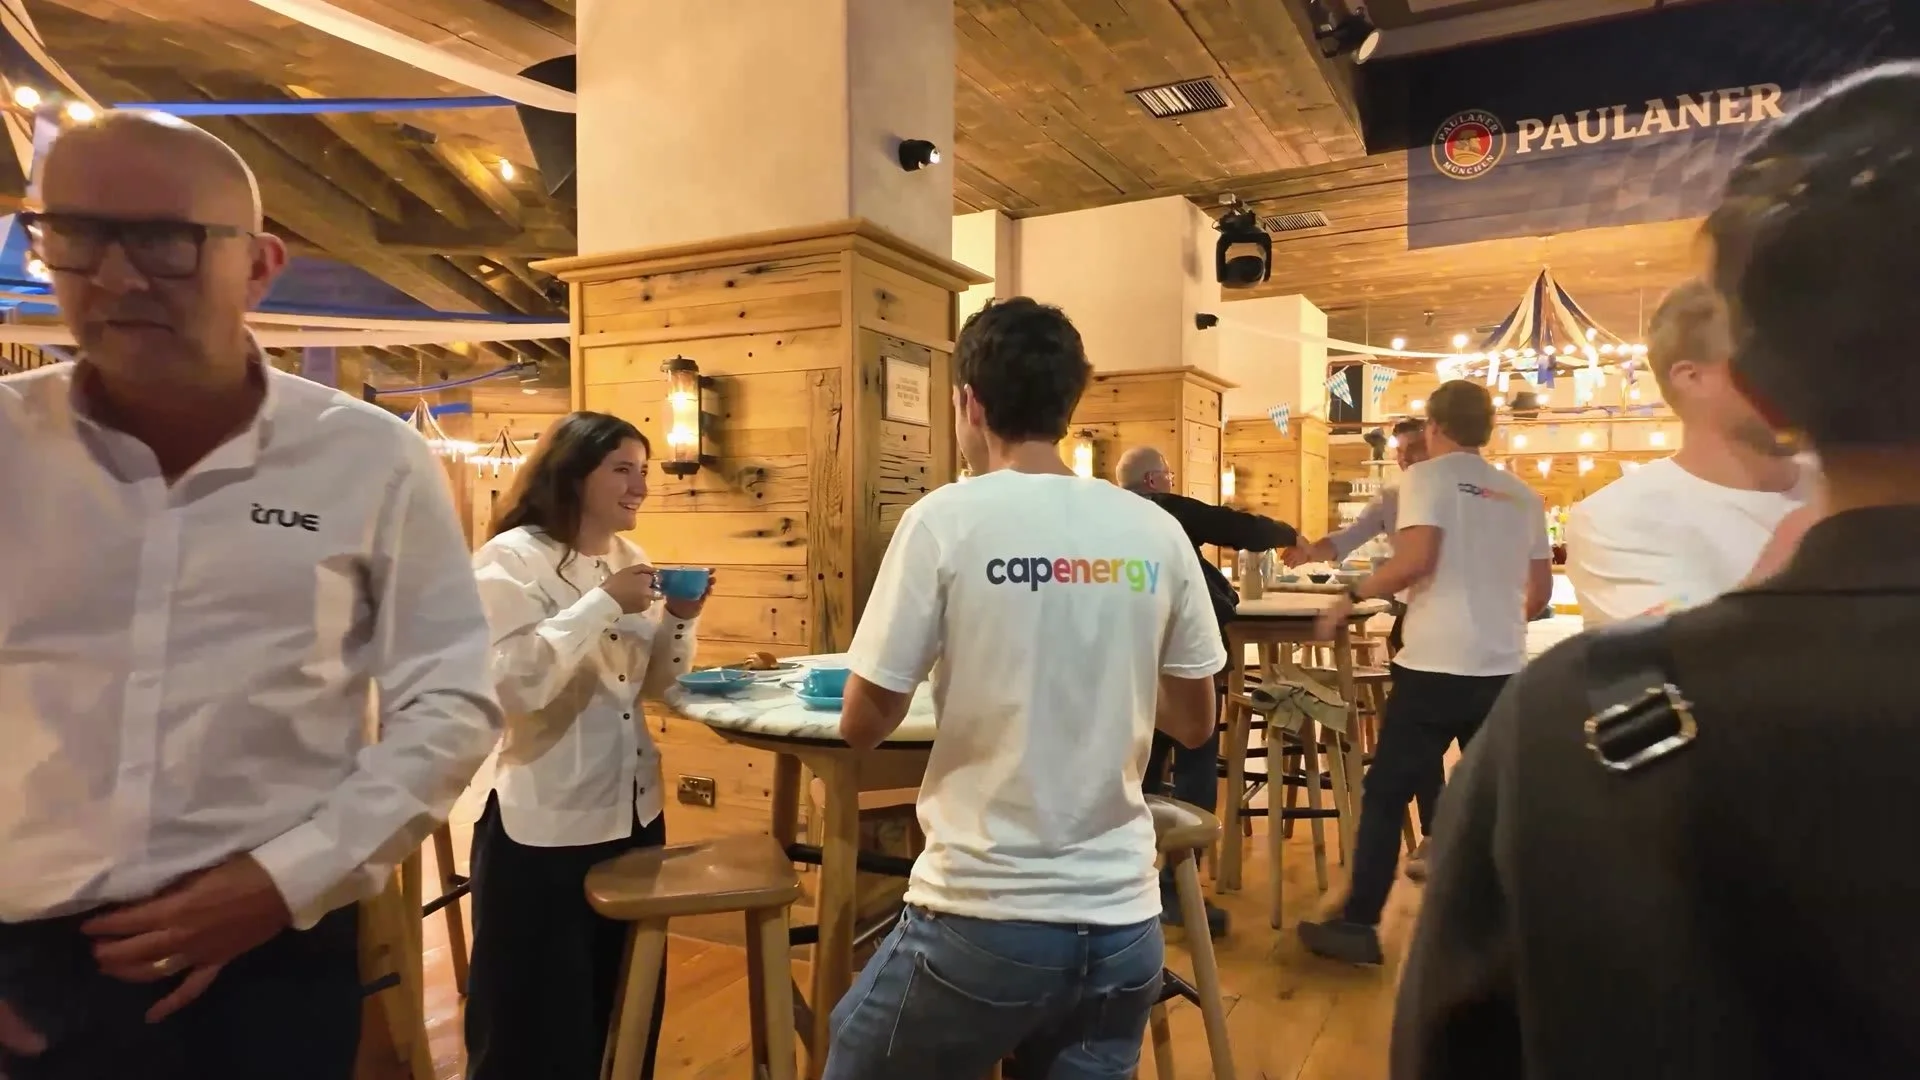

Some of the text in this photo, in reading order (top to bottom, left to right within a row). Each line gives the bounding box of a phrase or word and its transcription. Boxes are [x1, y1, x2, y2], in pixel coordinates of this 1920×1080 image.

[1438, 113, 1499, 141] PAULANER
[1516, 82, 1785, 153] PAULANER
[986, 557, 1160, 594] capenergy
